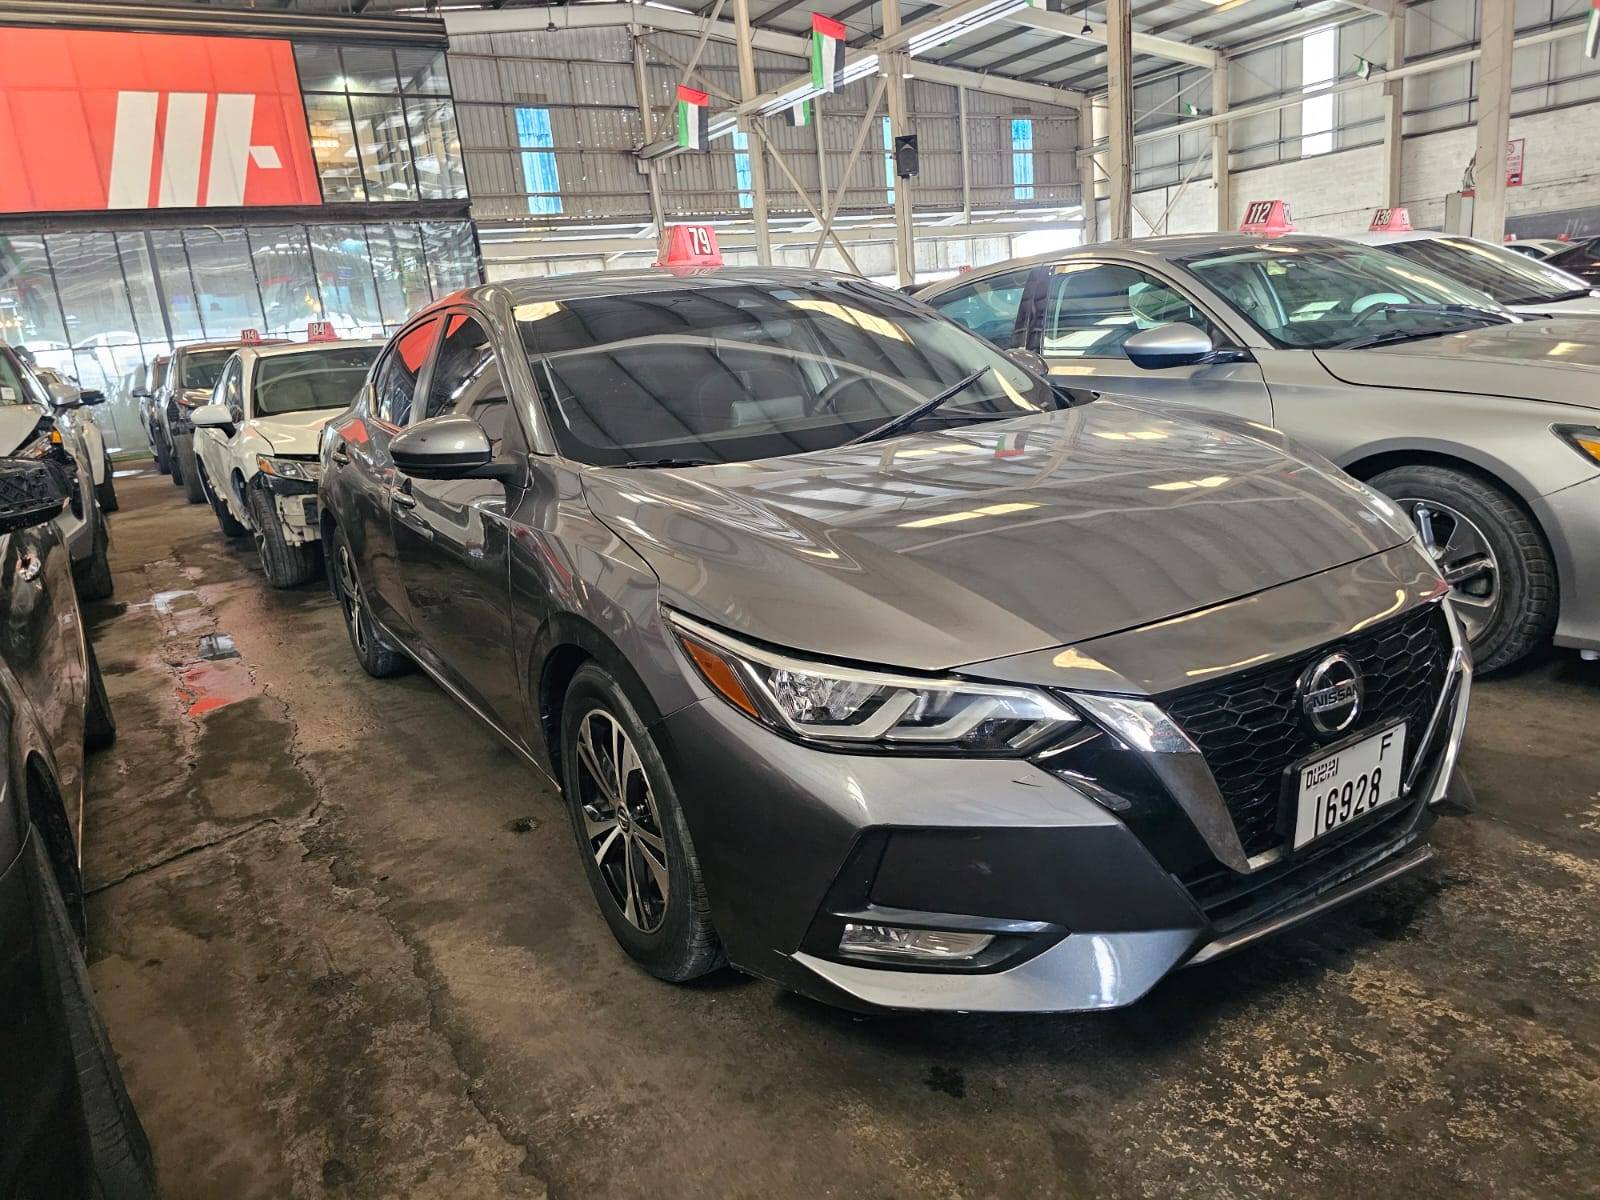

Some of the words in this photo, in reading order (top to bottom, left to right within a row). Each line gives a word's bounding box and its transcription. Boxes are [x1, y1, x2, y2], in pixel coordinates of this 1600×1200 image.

[1248, 202, 1271, 224] 112
[687, 227, 713, 255] 79
[313, 323, 325, 336] 84
[1313, 683, 1360, 708] NISSAN
[1380, 732, 1393, 761] F
[1314, 766, 1382, 838] 16928
